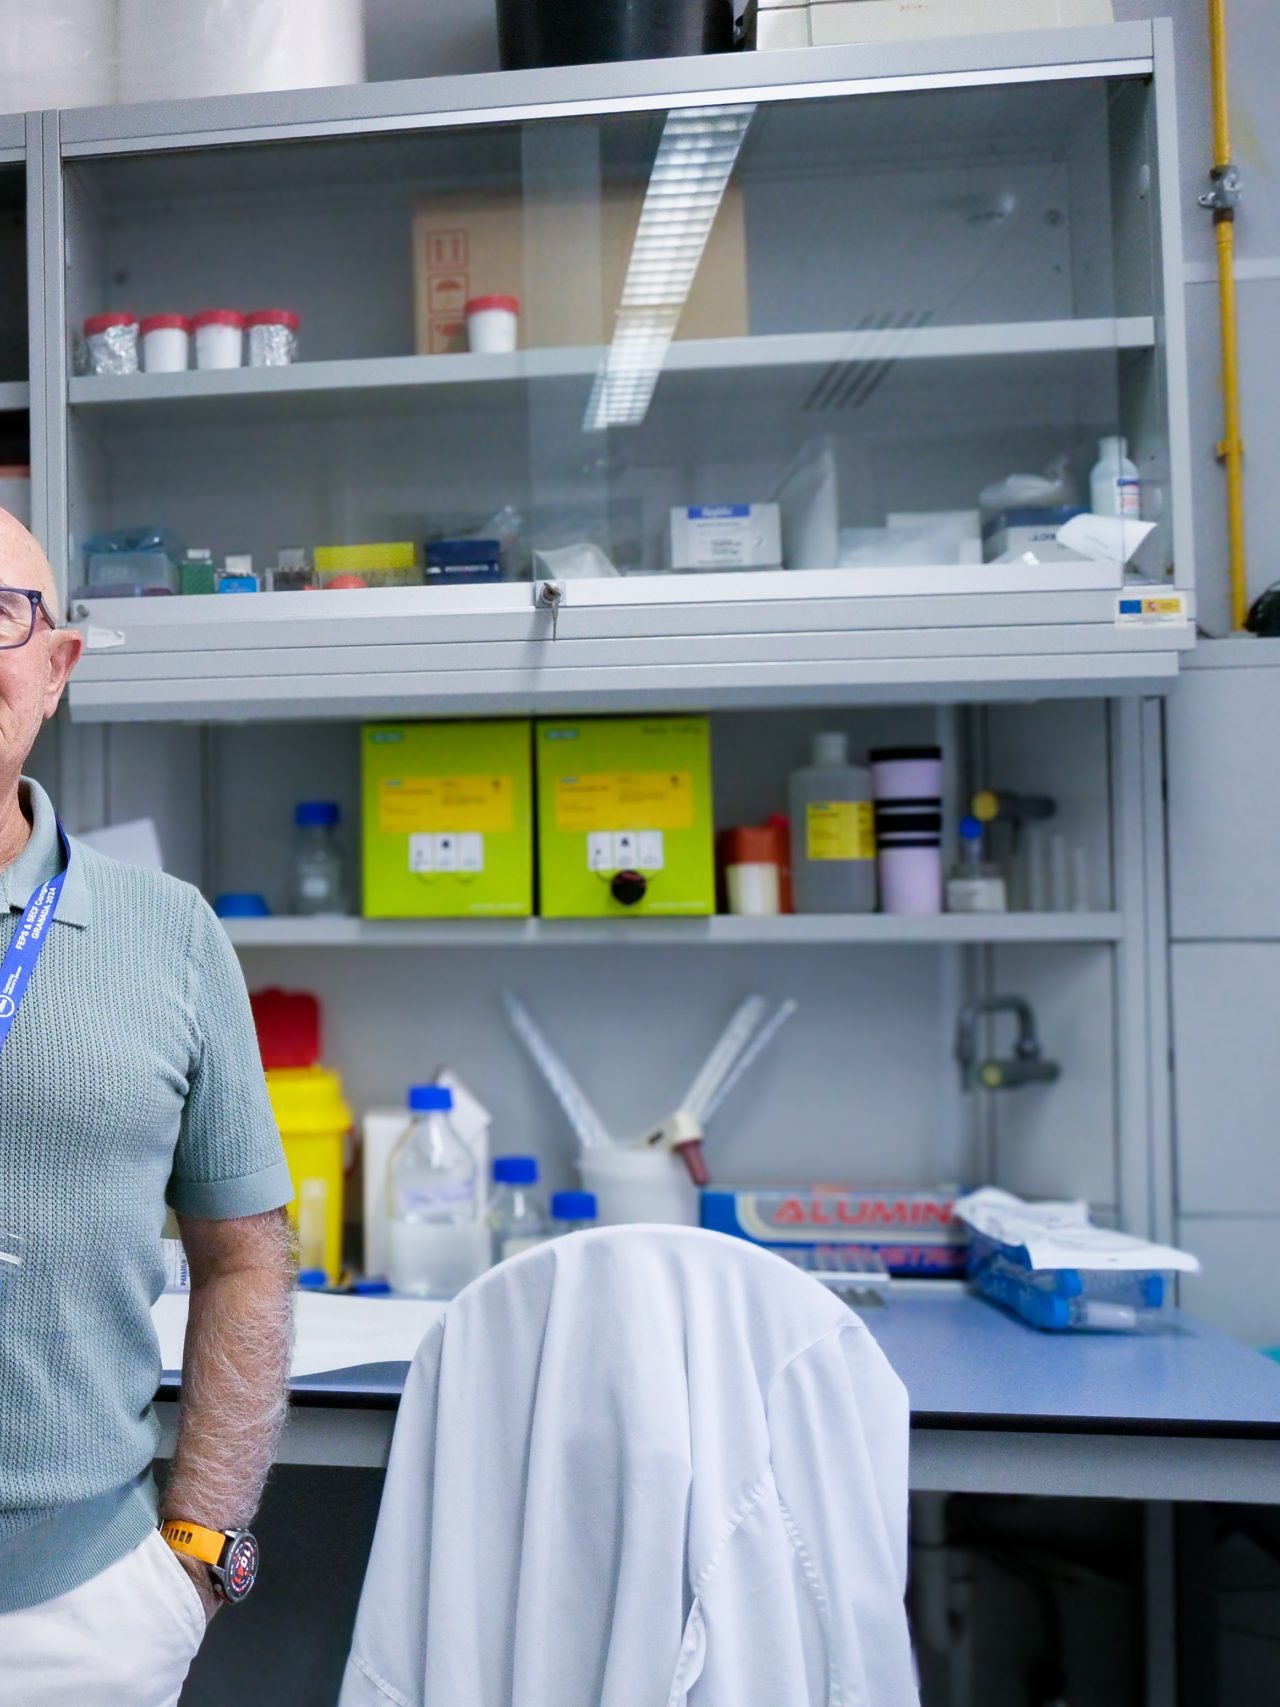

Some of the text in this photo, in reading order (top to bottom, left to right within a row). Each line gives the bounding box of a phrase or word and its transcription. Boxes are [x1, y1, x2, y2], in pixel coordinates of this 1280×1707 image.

[15, 930, 29, 950] FEPS
[26, 905, 39, 923] SECF
[30, 886, 57, 940] GRANADA 2024
[773, 1198, 958, 1225] ALUMIN
